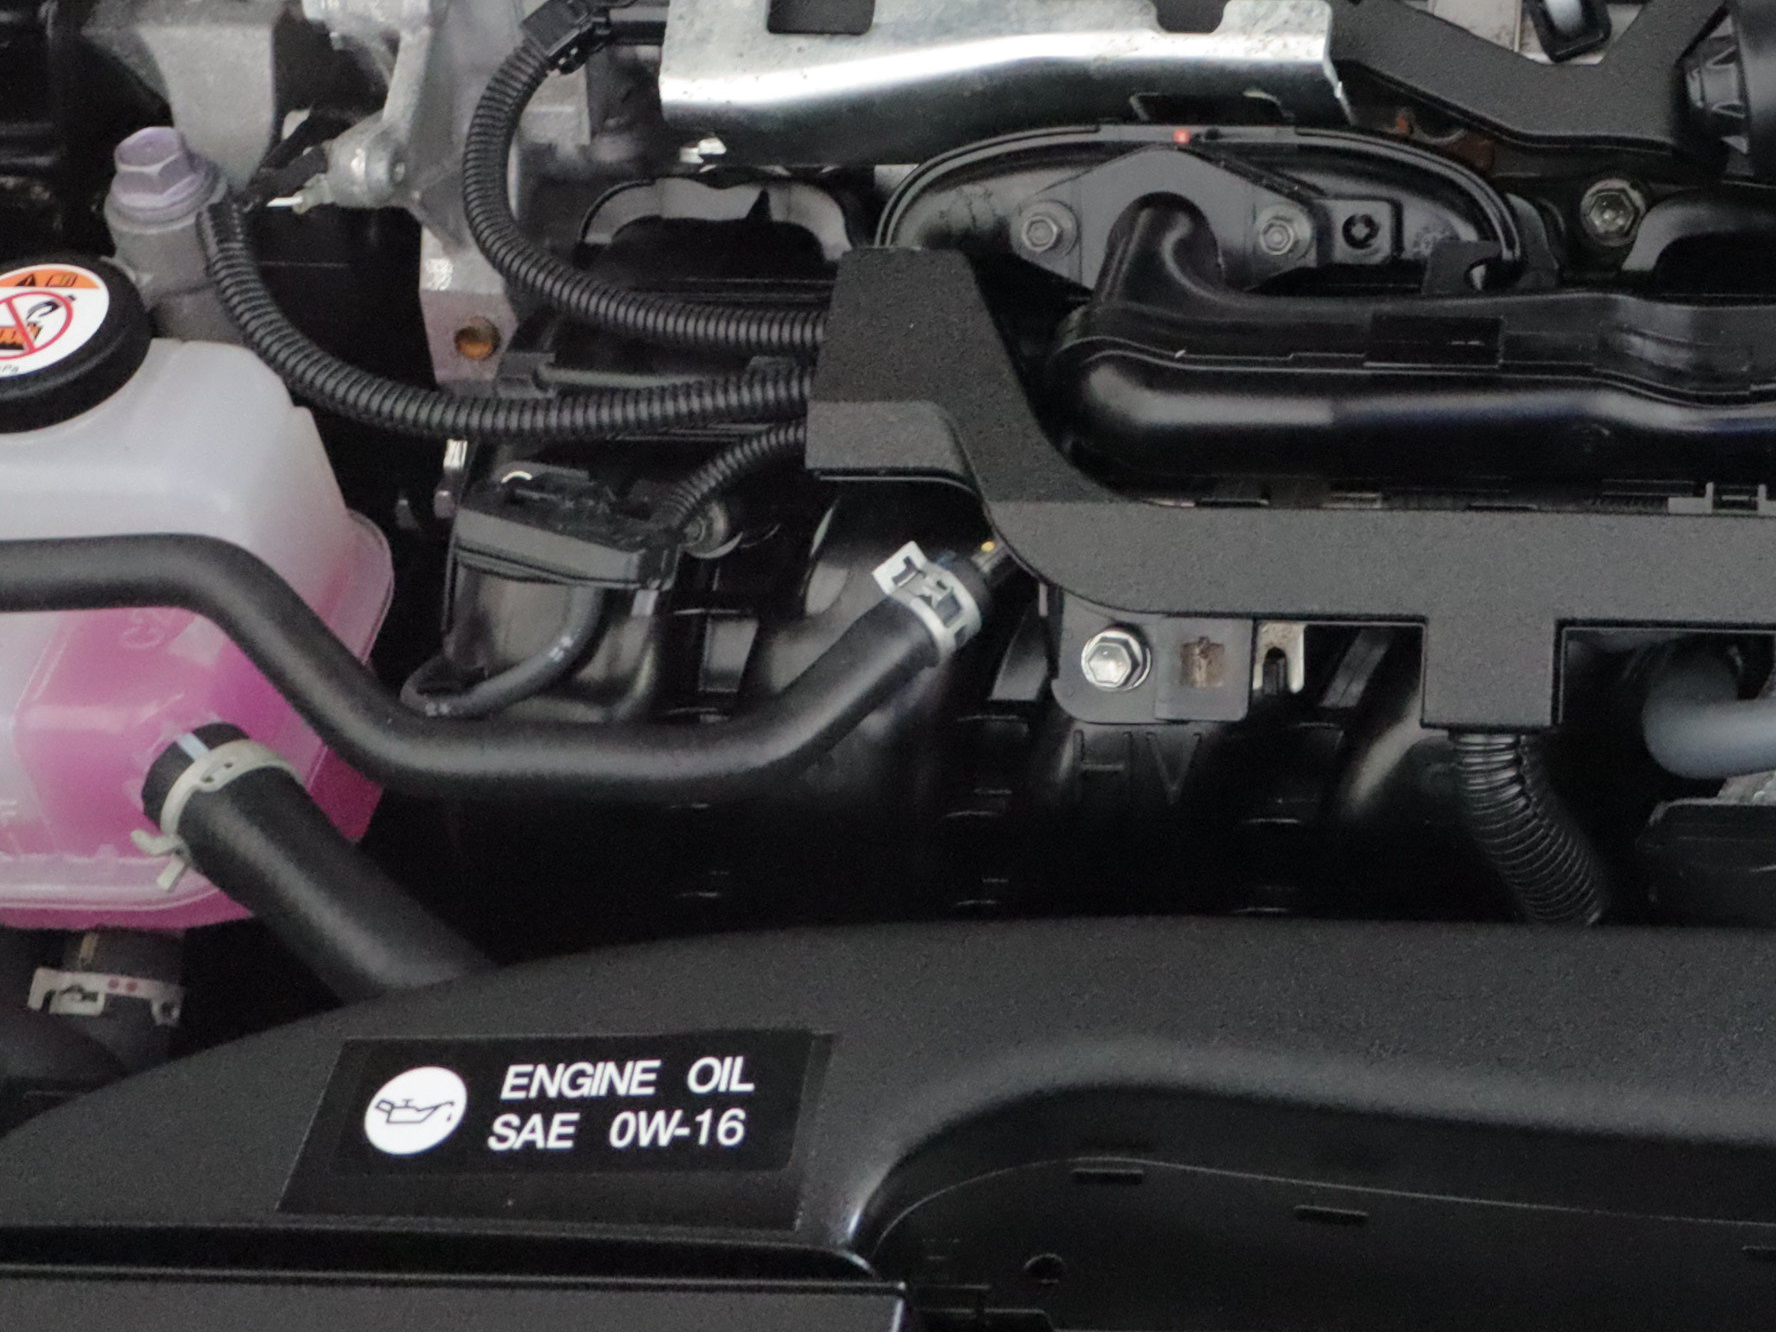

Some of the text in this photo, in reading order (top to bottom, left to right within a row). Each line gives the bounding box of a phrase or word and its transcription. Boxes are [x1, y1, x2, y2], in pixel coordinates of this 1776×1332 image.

[500, 1056, 755, 1101] ENGINE OIL
[487, 1107, 746, 1152] SAE 0W-16
